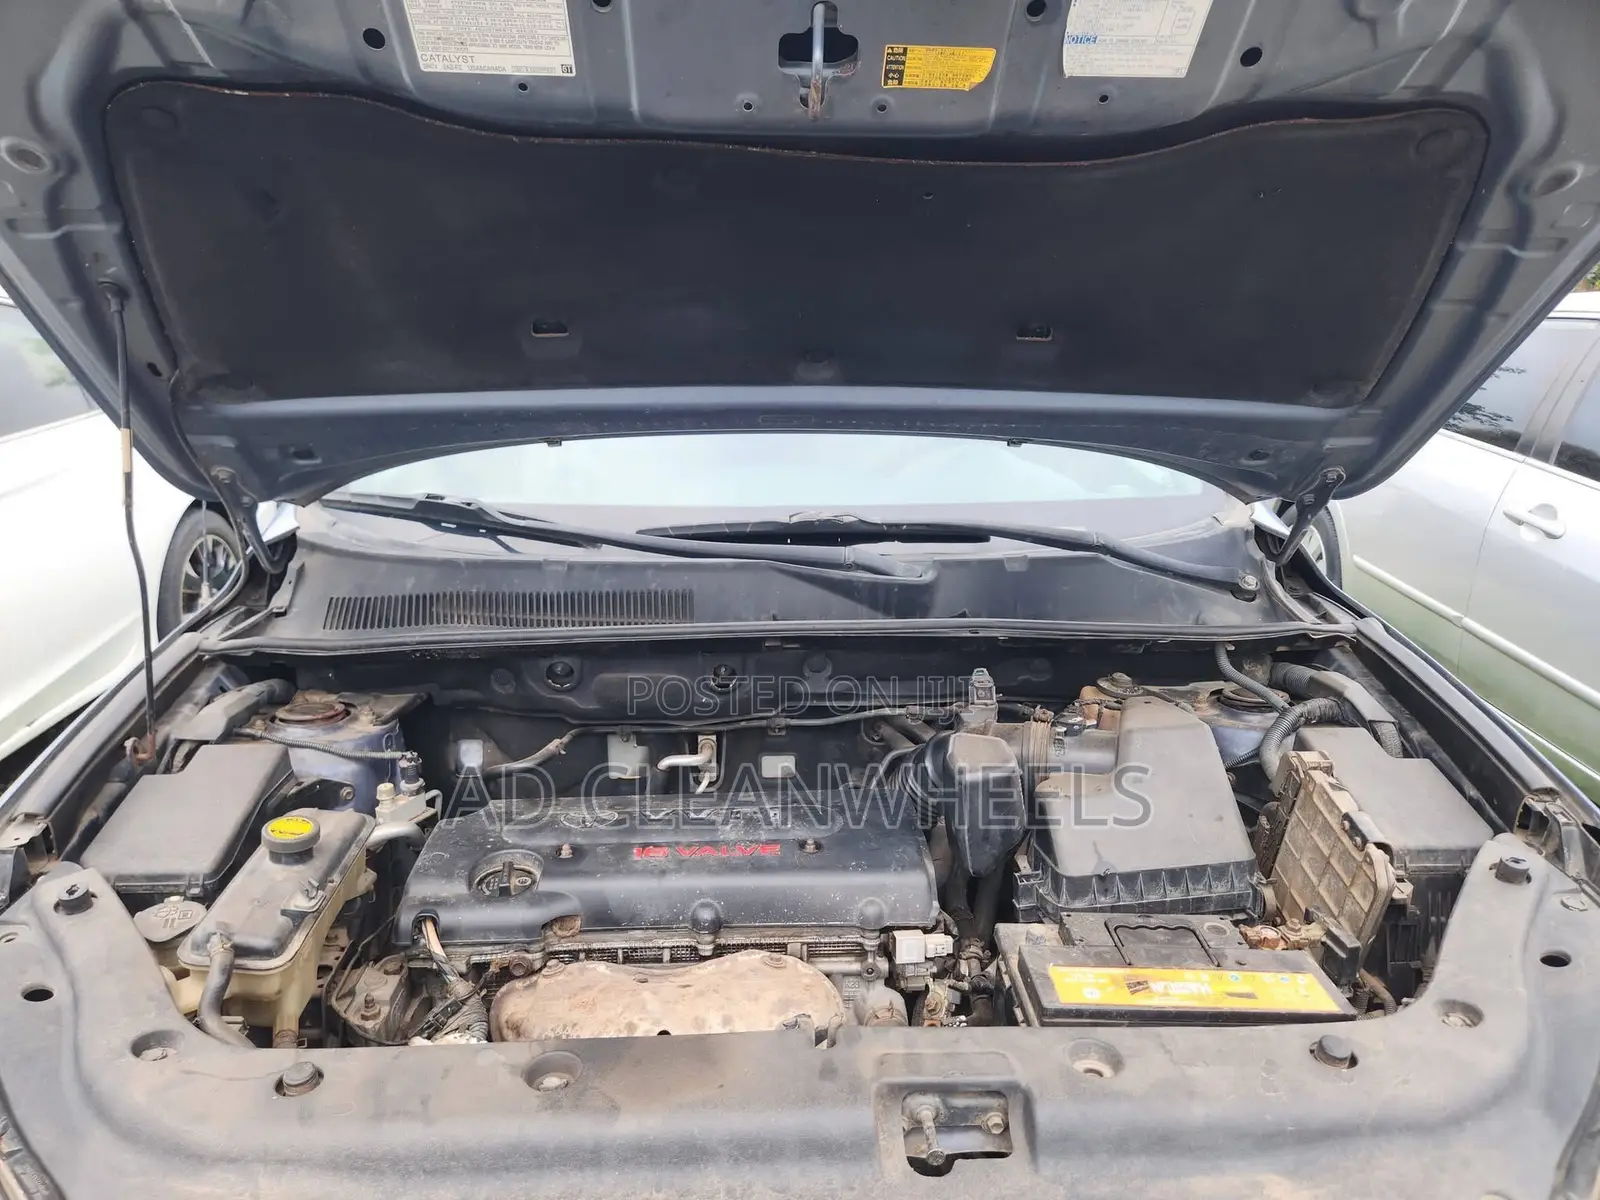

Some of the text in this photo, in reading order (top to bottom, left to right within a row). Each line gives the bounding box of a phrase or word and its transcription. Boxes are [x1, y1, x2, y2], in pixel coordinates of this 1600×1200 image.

[1064, 35, 1096, 45] NOTICE
[421, 53, 476, 64] CATALYST
[676, 843, 782, 857] VALVE
